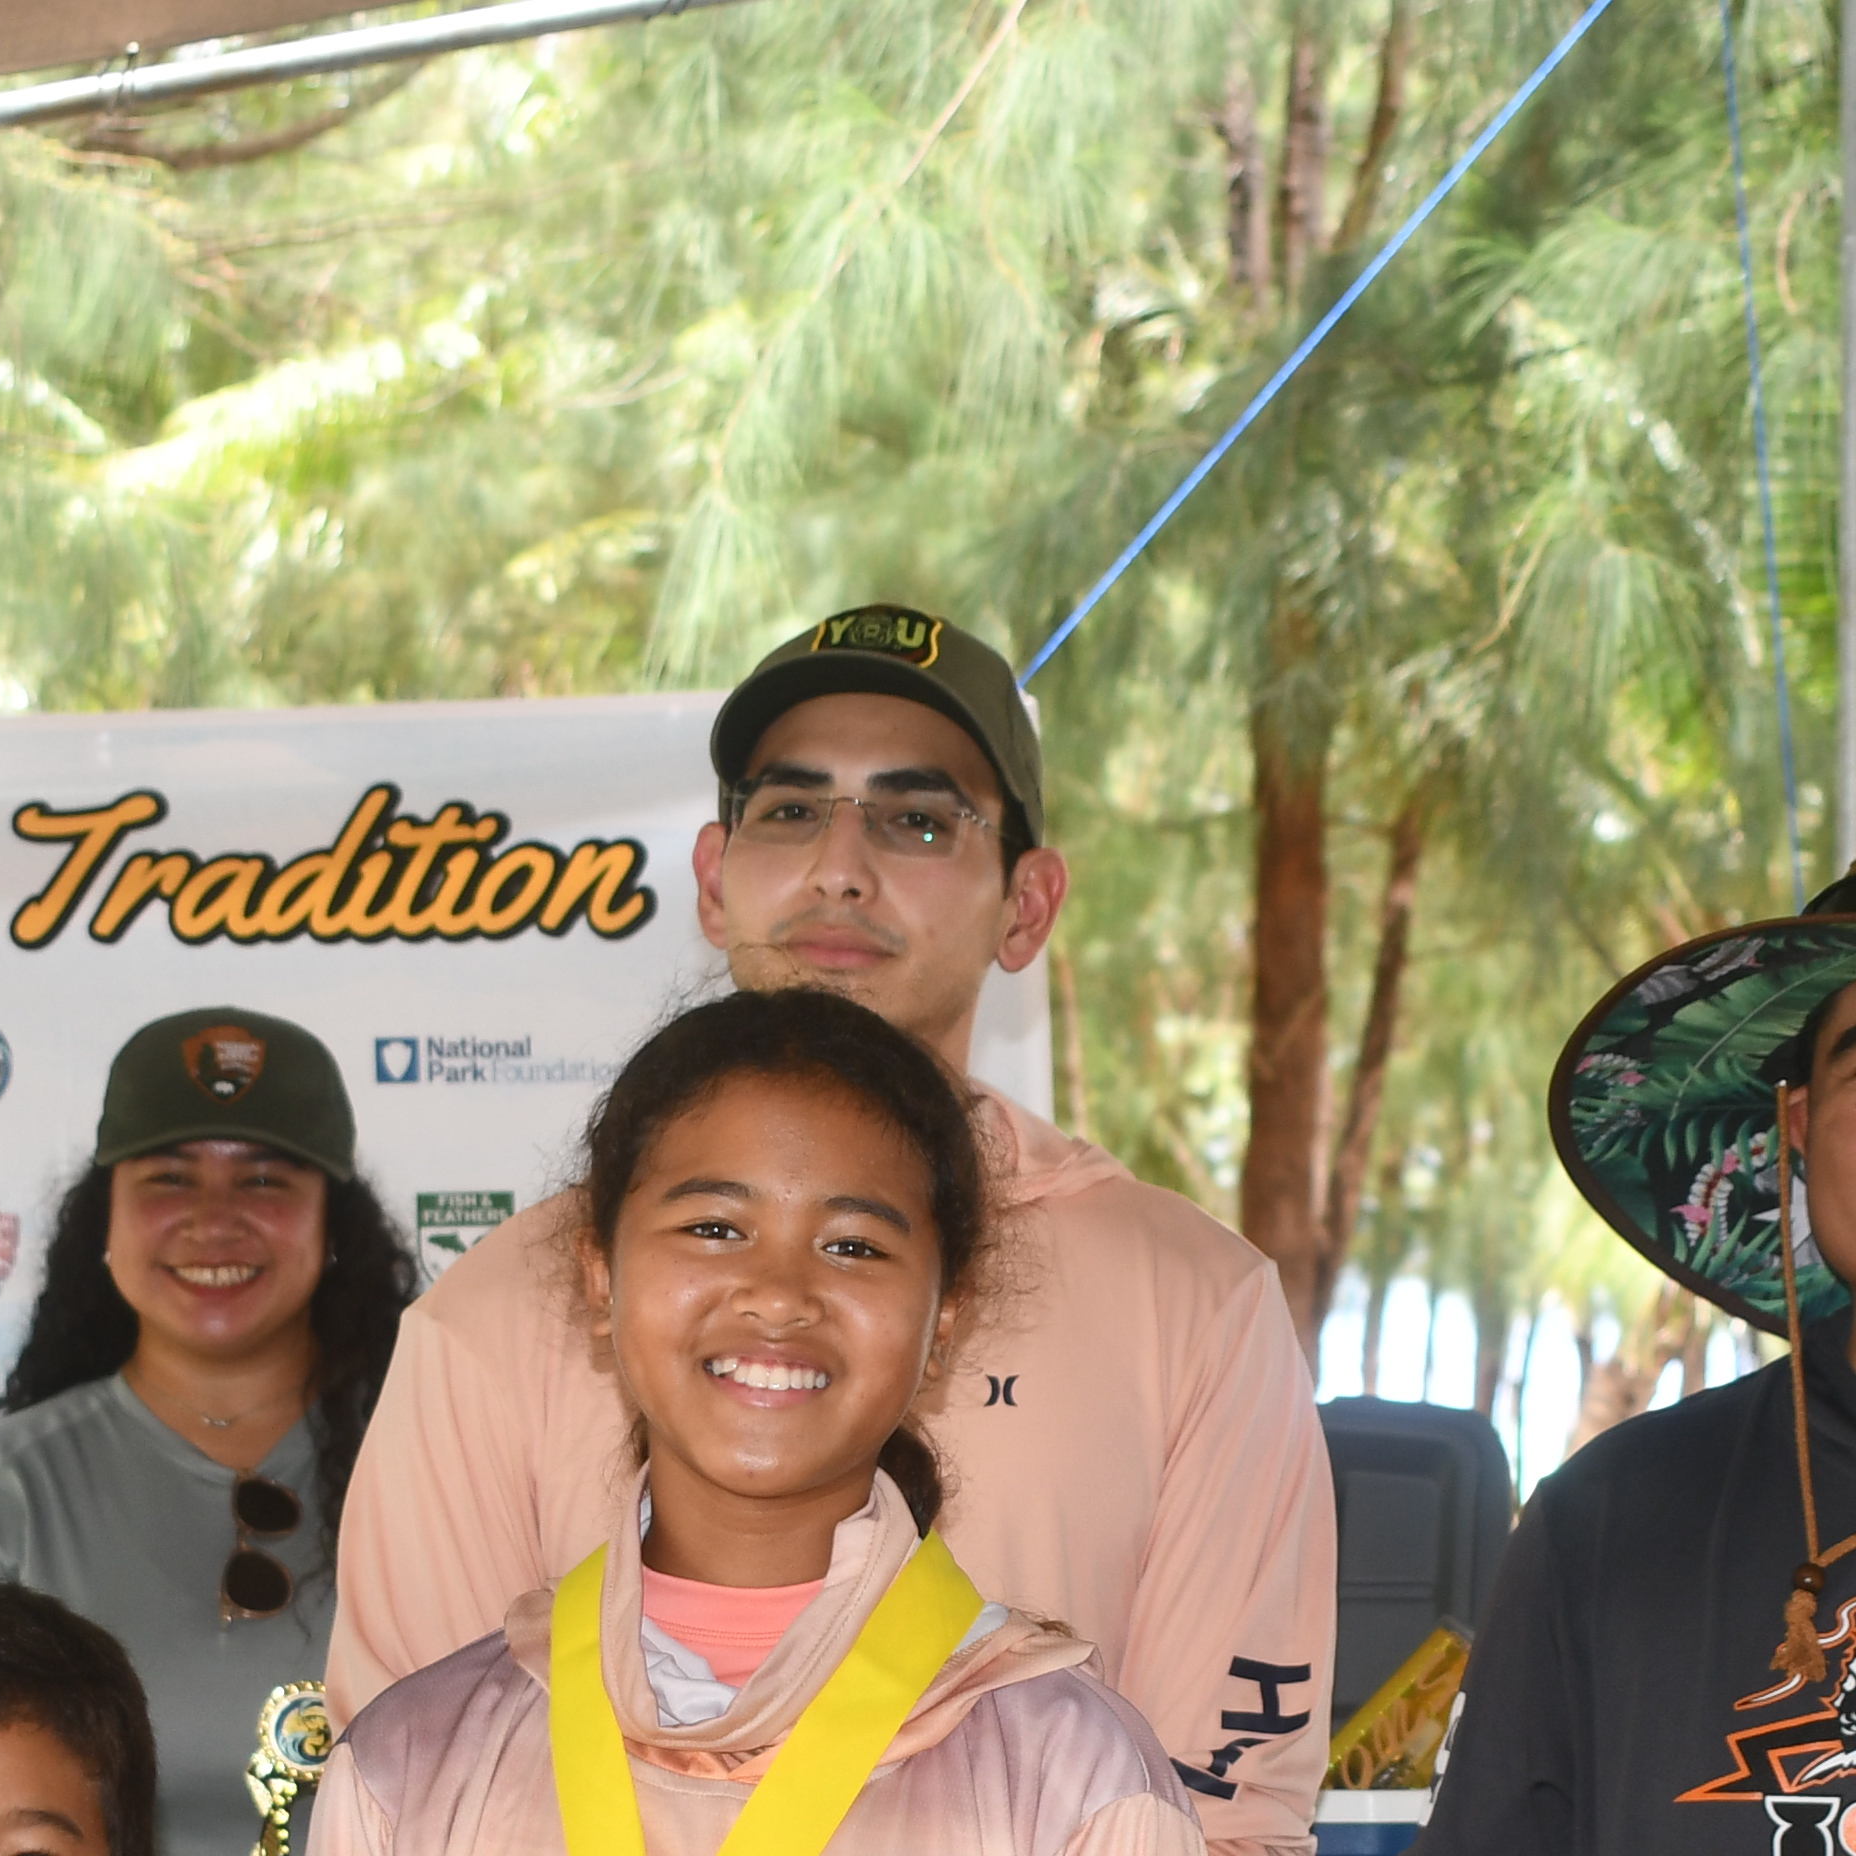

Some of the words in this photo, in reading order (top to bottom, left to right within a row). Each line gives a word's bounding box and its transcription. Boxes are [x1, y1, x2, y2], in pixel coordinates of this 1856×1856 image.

[9, 782, 655, 946] Tradition
[427, 1035, 532, 1058] National
[428, 1060, 486, 1082] Park
